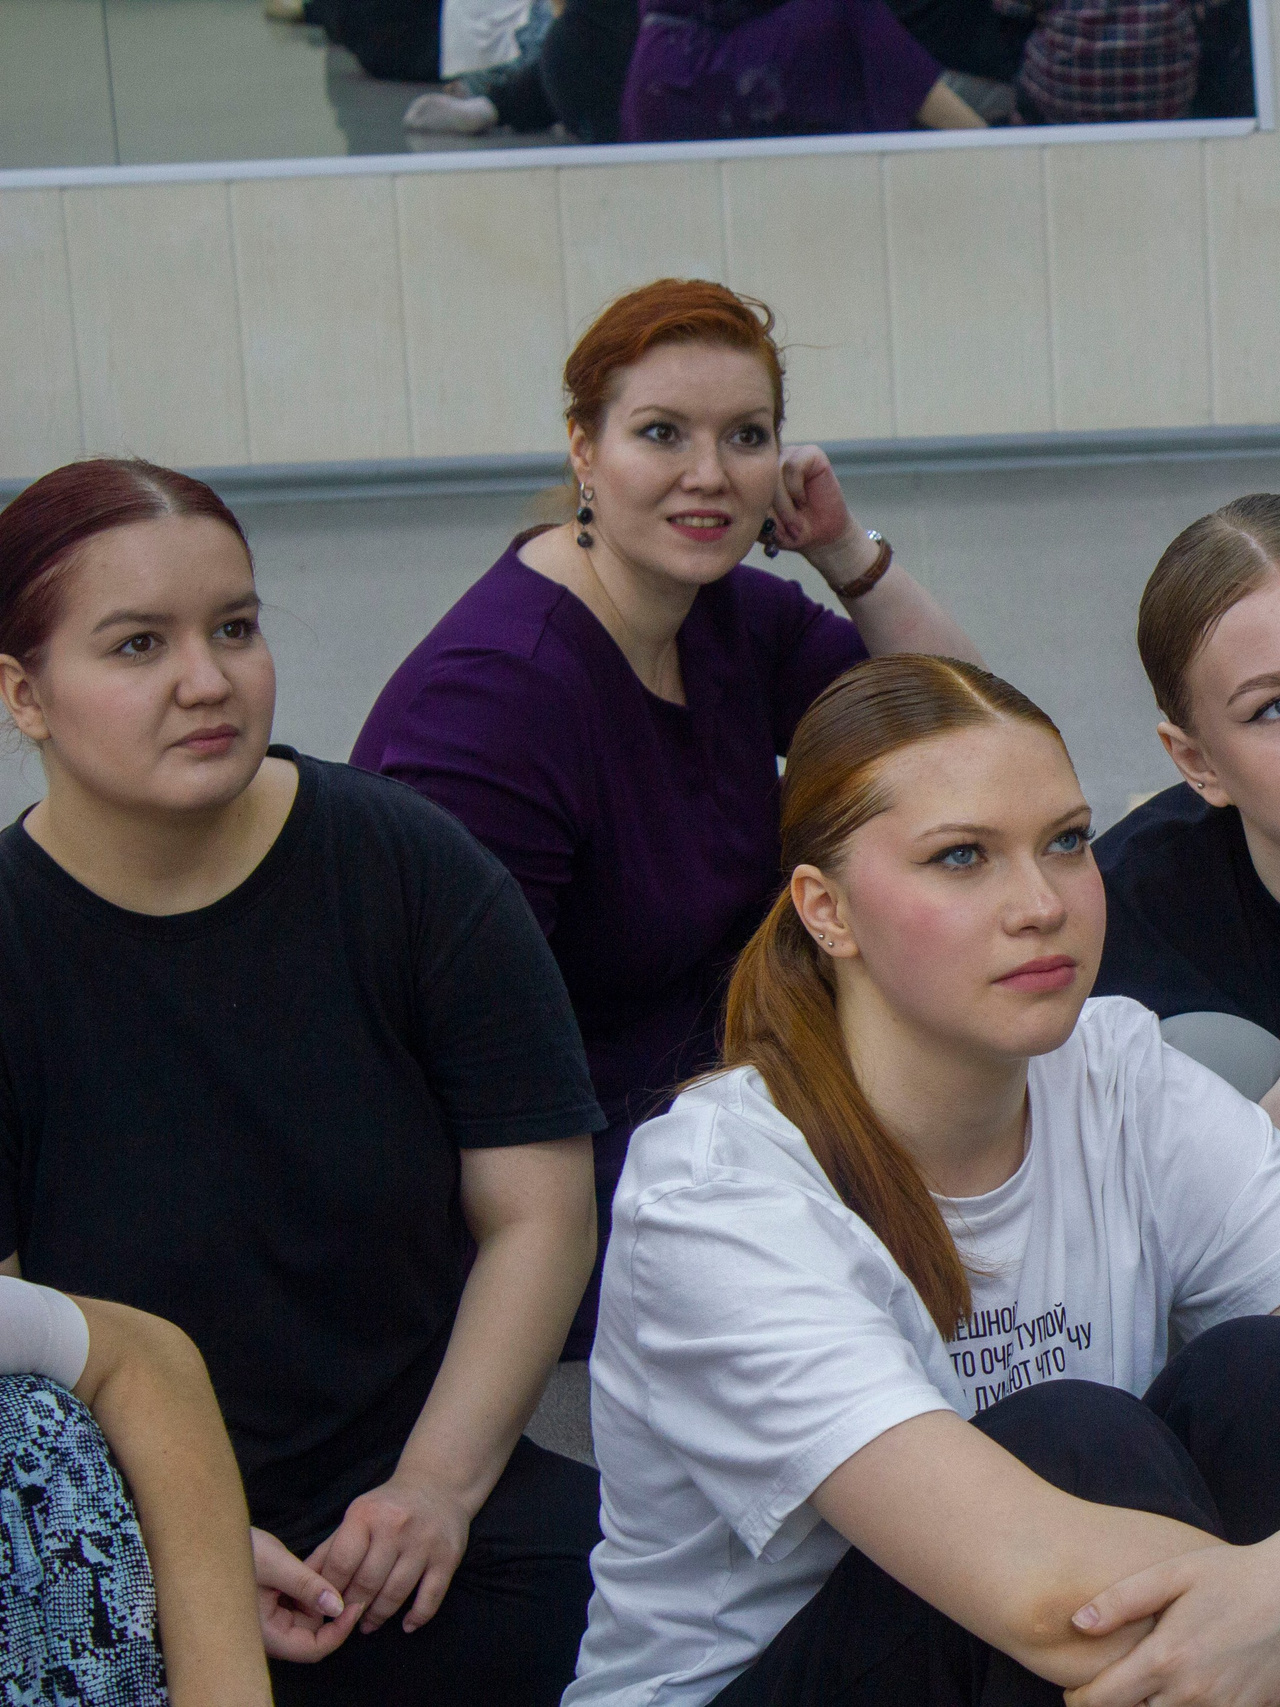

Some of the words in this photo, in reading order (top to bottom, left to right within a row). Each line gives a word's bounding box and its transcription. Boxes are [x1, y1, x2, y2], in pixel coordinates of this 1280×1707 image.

[952, 1301, 1018, 1342] ЕШНО
[1014, 1302, 1067, 1350] ТУПОЙ
[975, 1359, 1032, 1413] ДУЮТ
[1035, 1346, 1066, 1379] ЧТО
